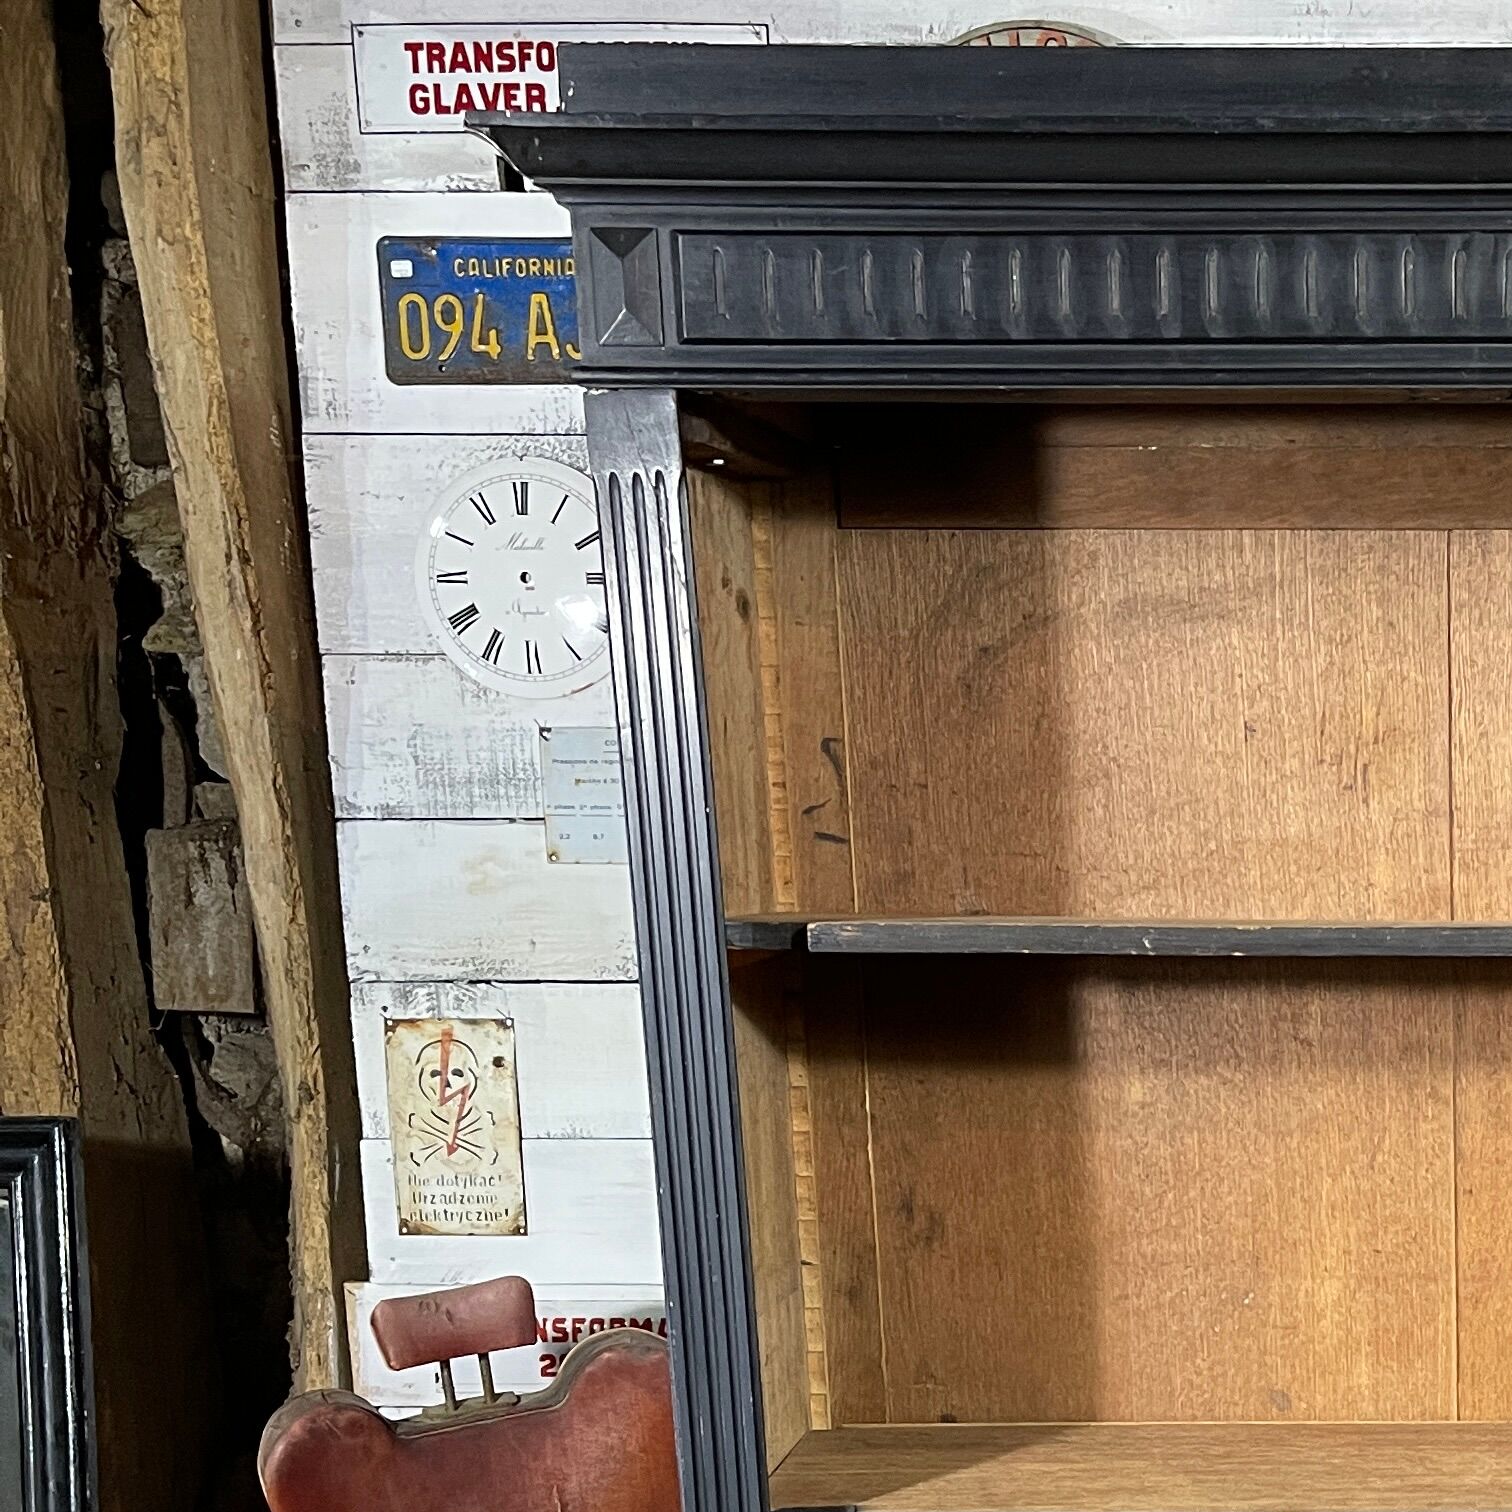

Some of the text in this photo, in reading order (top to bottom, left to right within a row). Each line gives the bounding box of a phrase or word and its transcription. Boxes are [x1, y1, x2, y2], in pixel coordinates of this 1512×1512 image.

[404, 41, 555, 73] TRANSFO
[408, 83, 546, 115] GLAVER
[454, 258, 576, 279] CALIFORNIA
[398, 292, 502, 361] 094
